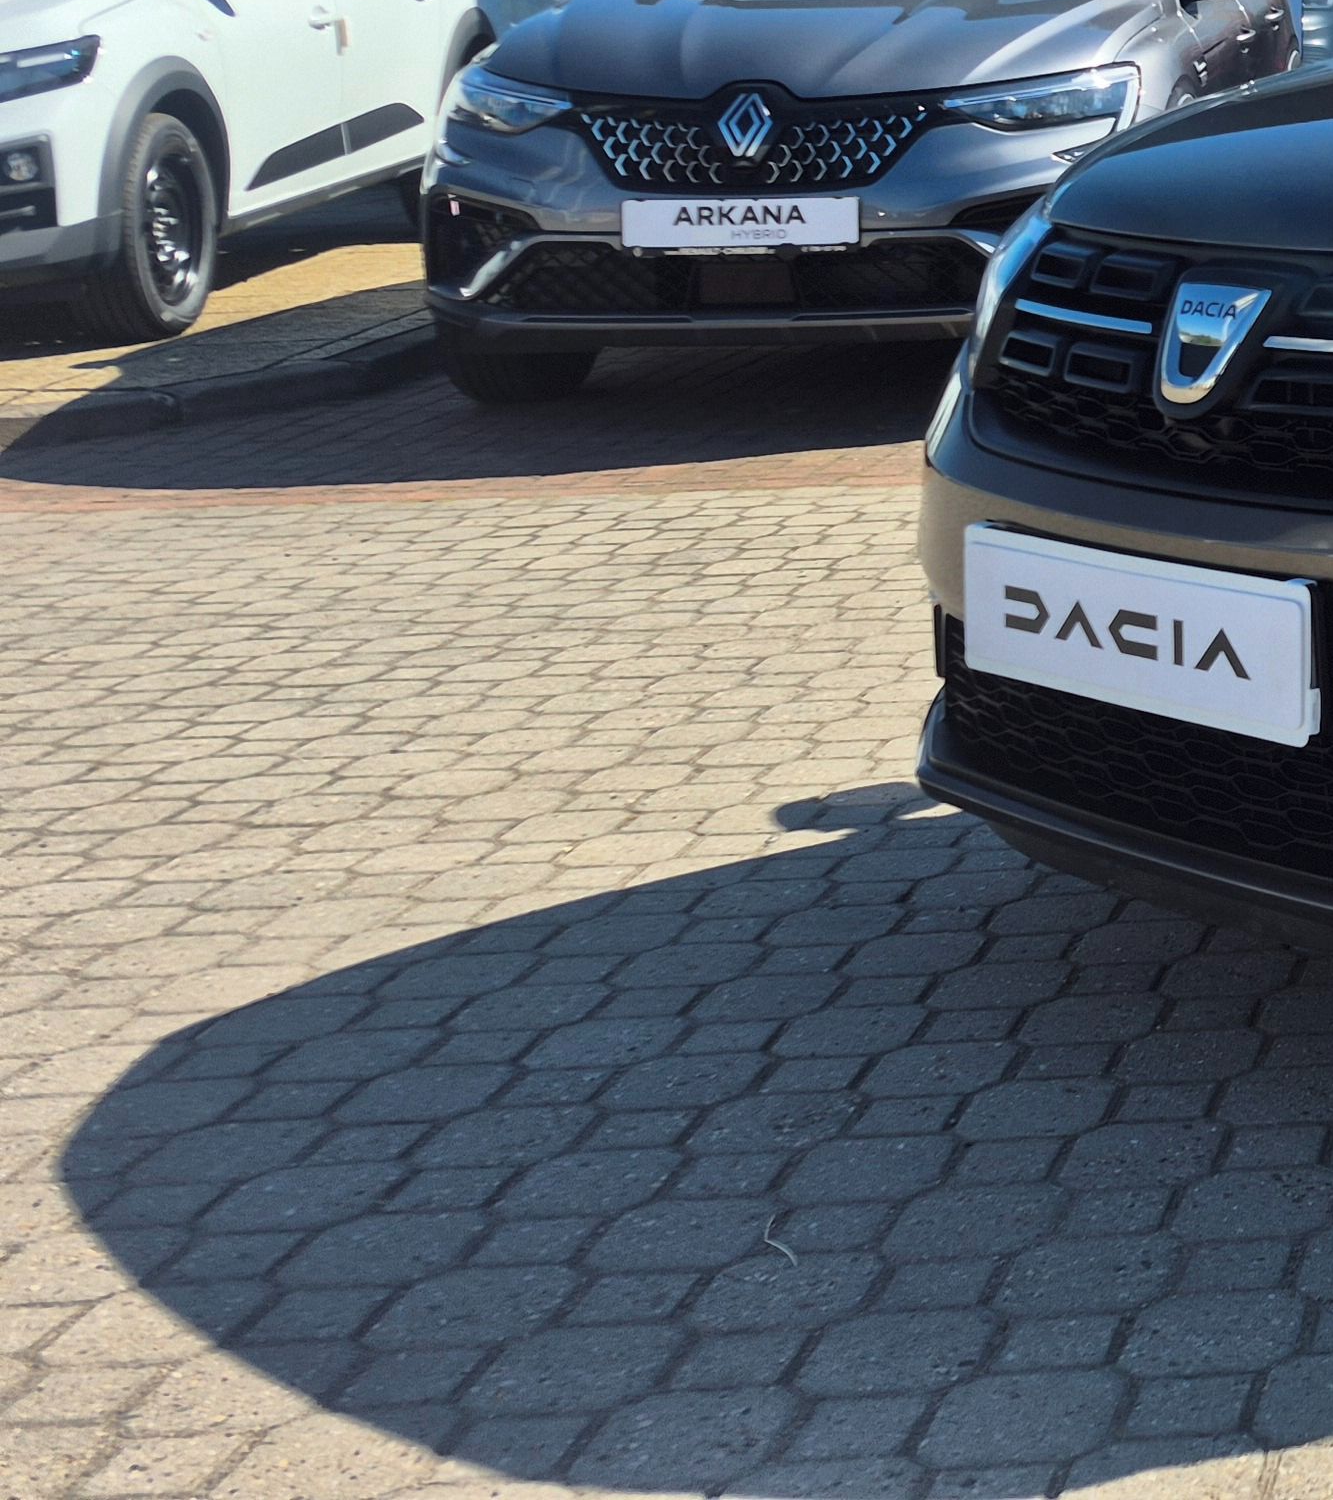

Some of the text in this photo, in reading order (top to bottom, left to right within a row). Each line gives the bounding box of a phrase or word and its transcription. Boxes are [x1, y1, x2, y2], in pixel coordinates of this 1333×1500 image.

[673, 205, 806, 226] ARKANA
[731, 228, 788, 240] HYBRID
[1181, 300, 1236, 319] DACIA
[1005, 584, 1251, 680] DACIA
